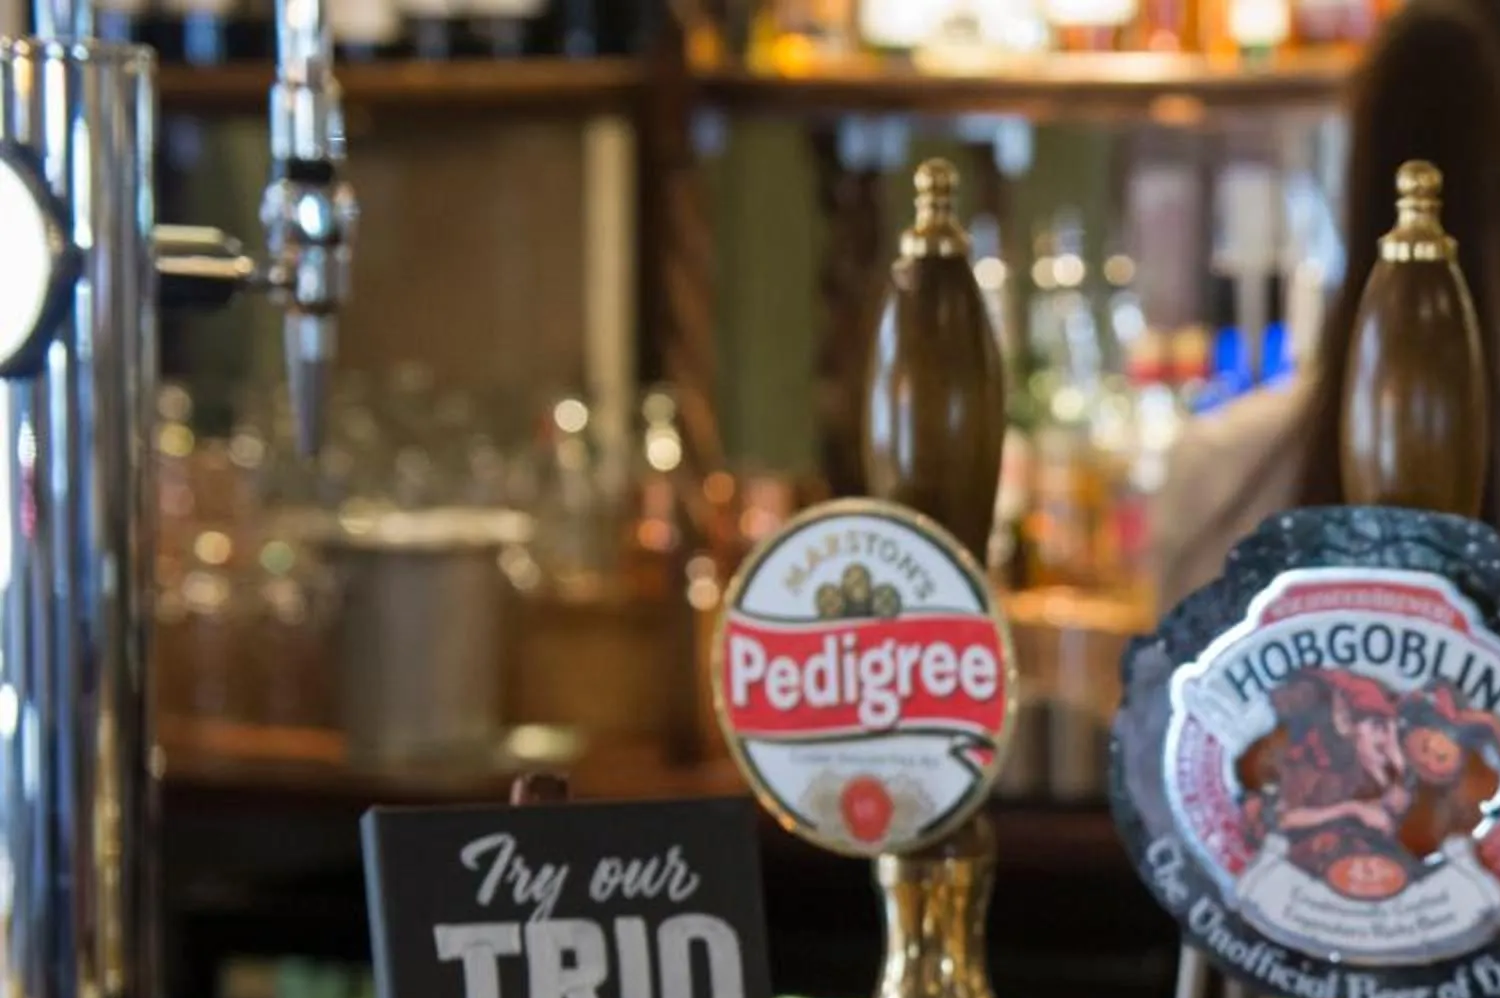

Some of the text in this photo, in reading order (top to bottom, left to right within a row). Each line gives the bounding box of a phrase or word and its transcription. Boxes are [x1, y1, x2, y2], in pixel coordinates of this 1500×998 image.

[728, 632, 999, 729] Pedigree
[459, 832, 700, 922] Try our
